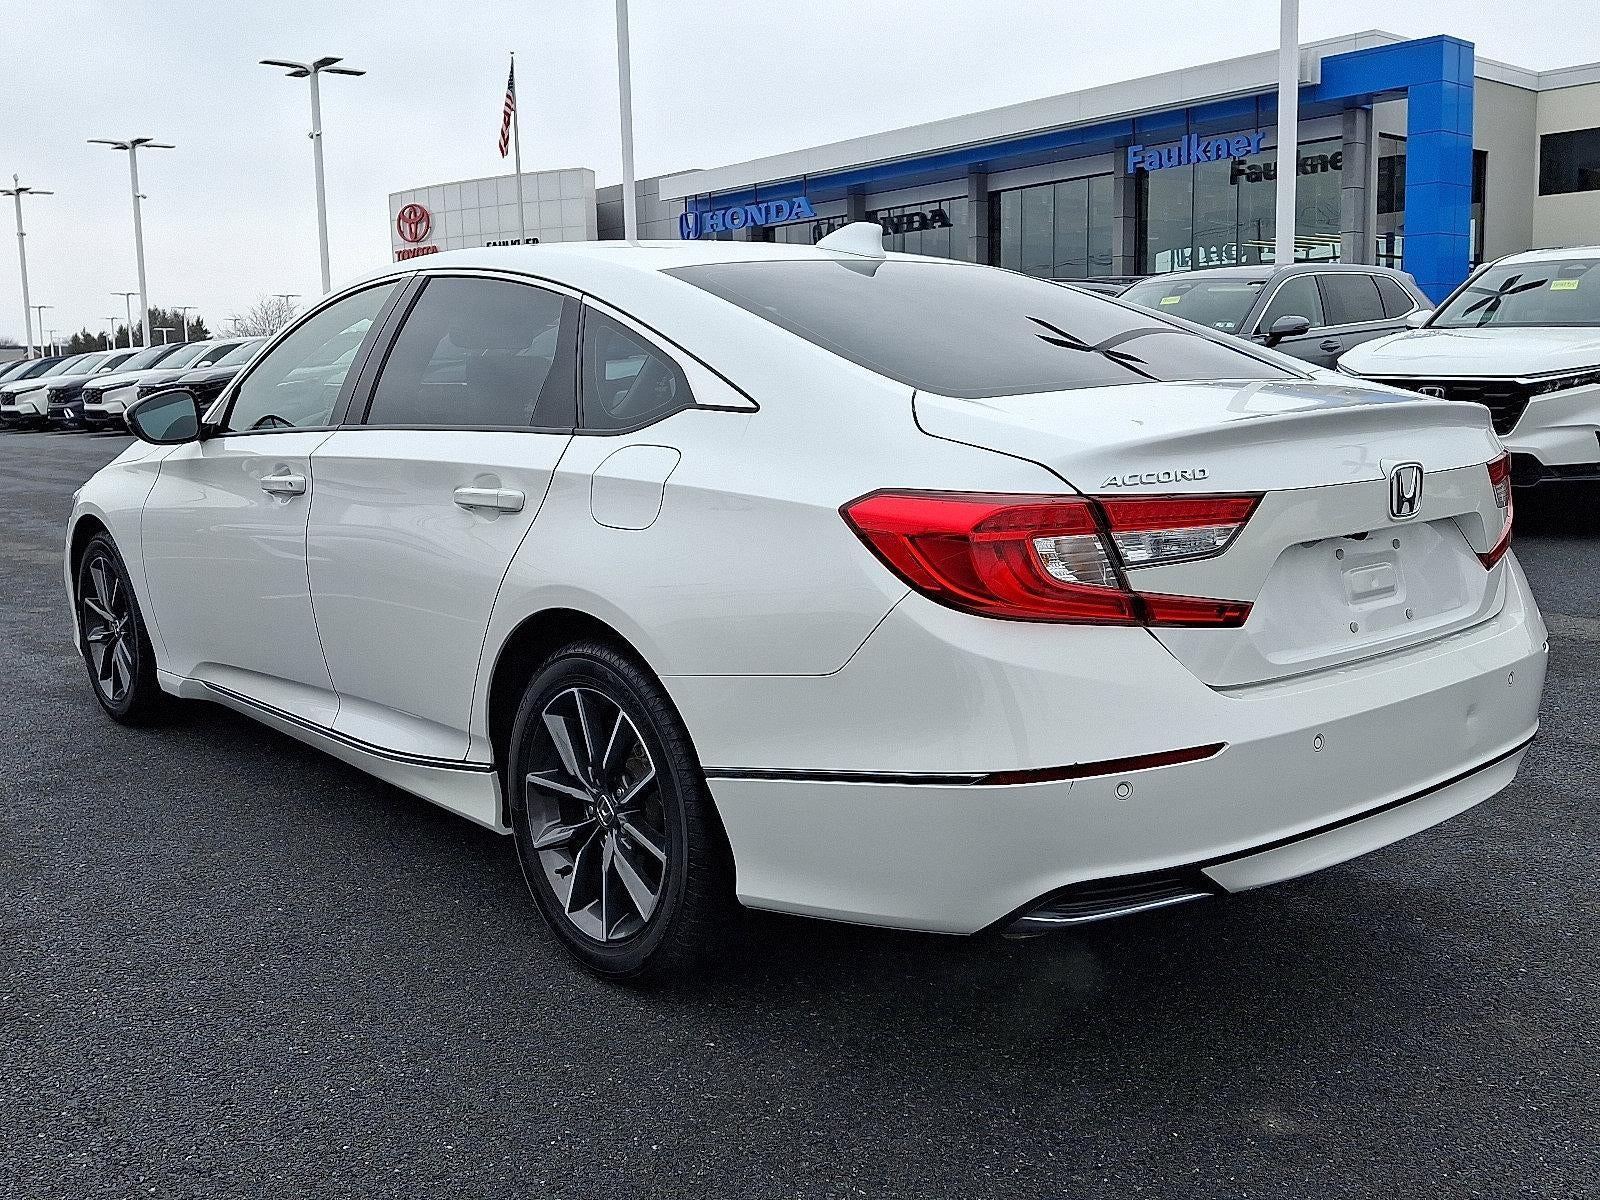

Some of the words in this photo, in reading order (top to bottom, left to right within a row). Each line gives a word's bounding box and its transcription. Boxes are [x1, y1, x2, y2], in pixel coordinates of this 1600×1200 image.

[1127, 133, 1264, 174] Faulkner
[703, 196, 816, 233] HONDA
[395, 245, 438, 262] TOYOTA
[1099, 468, 1209, 488] ACCORD
